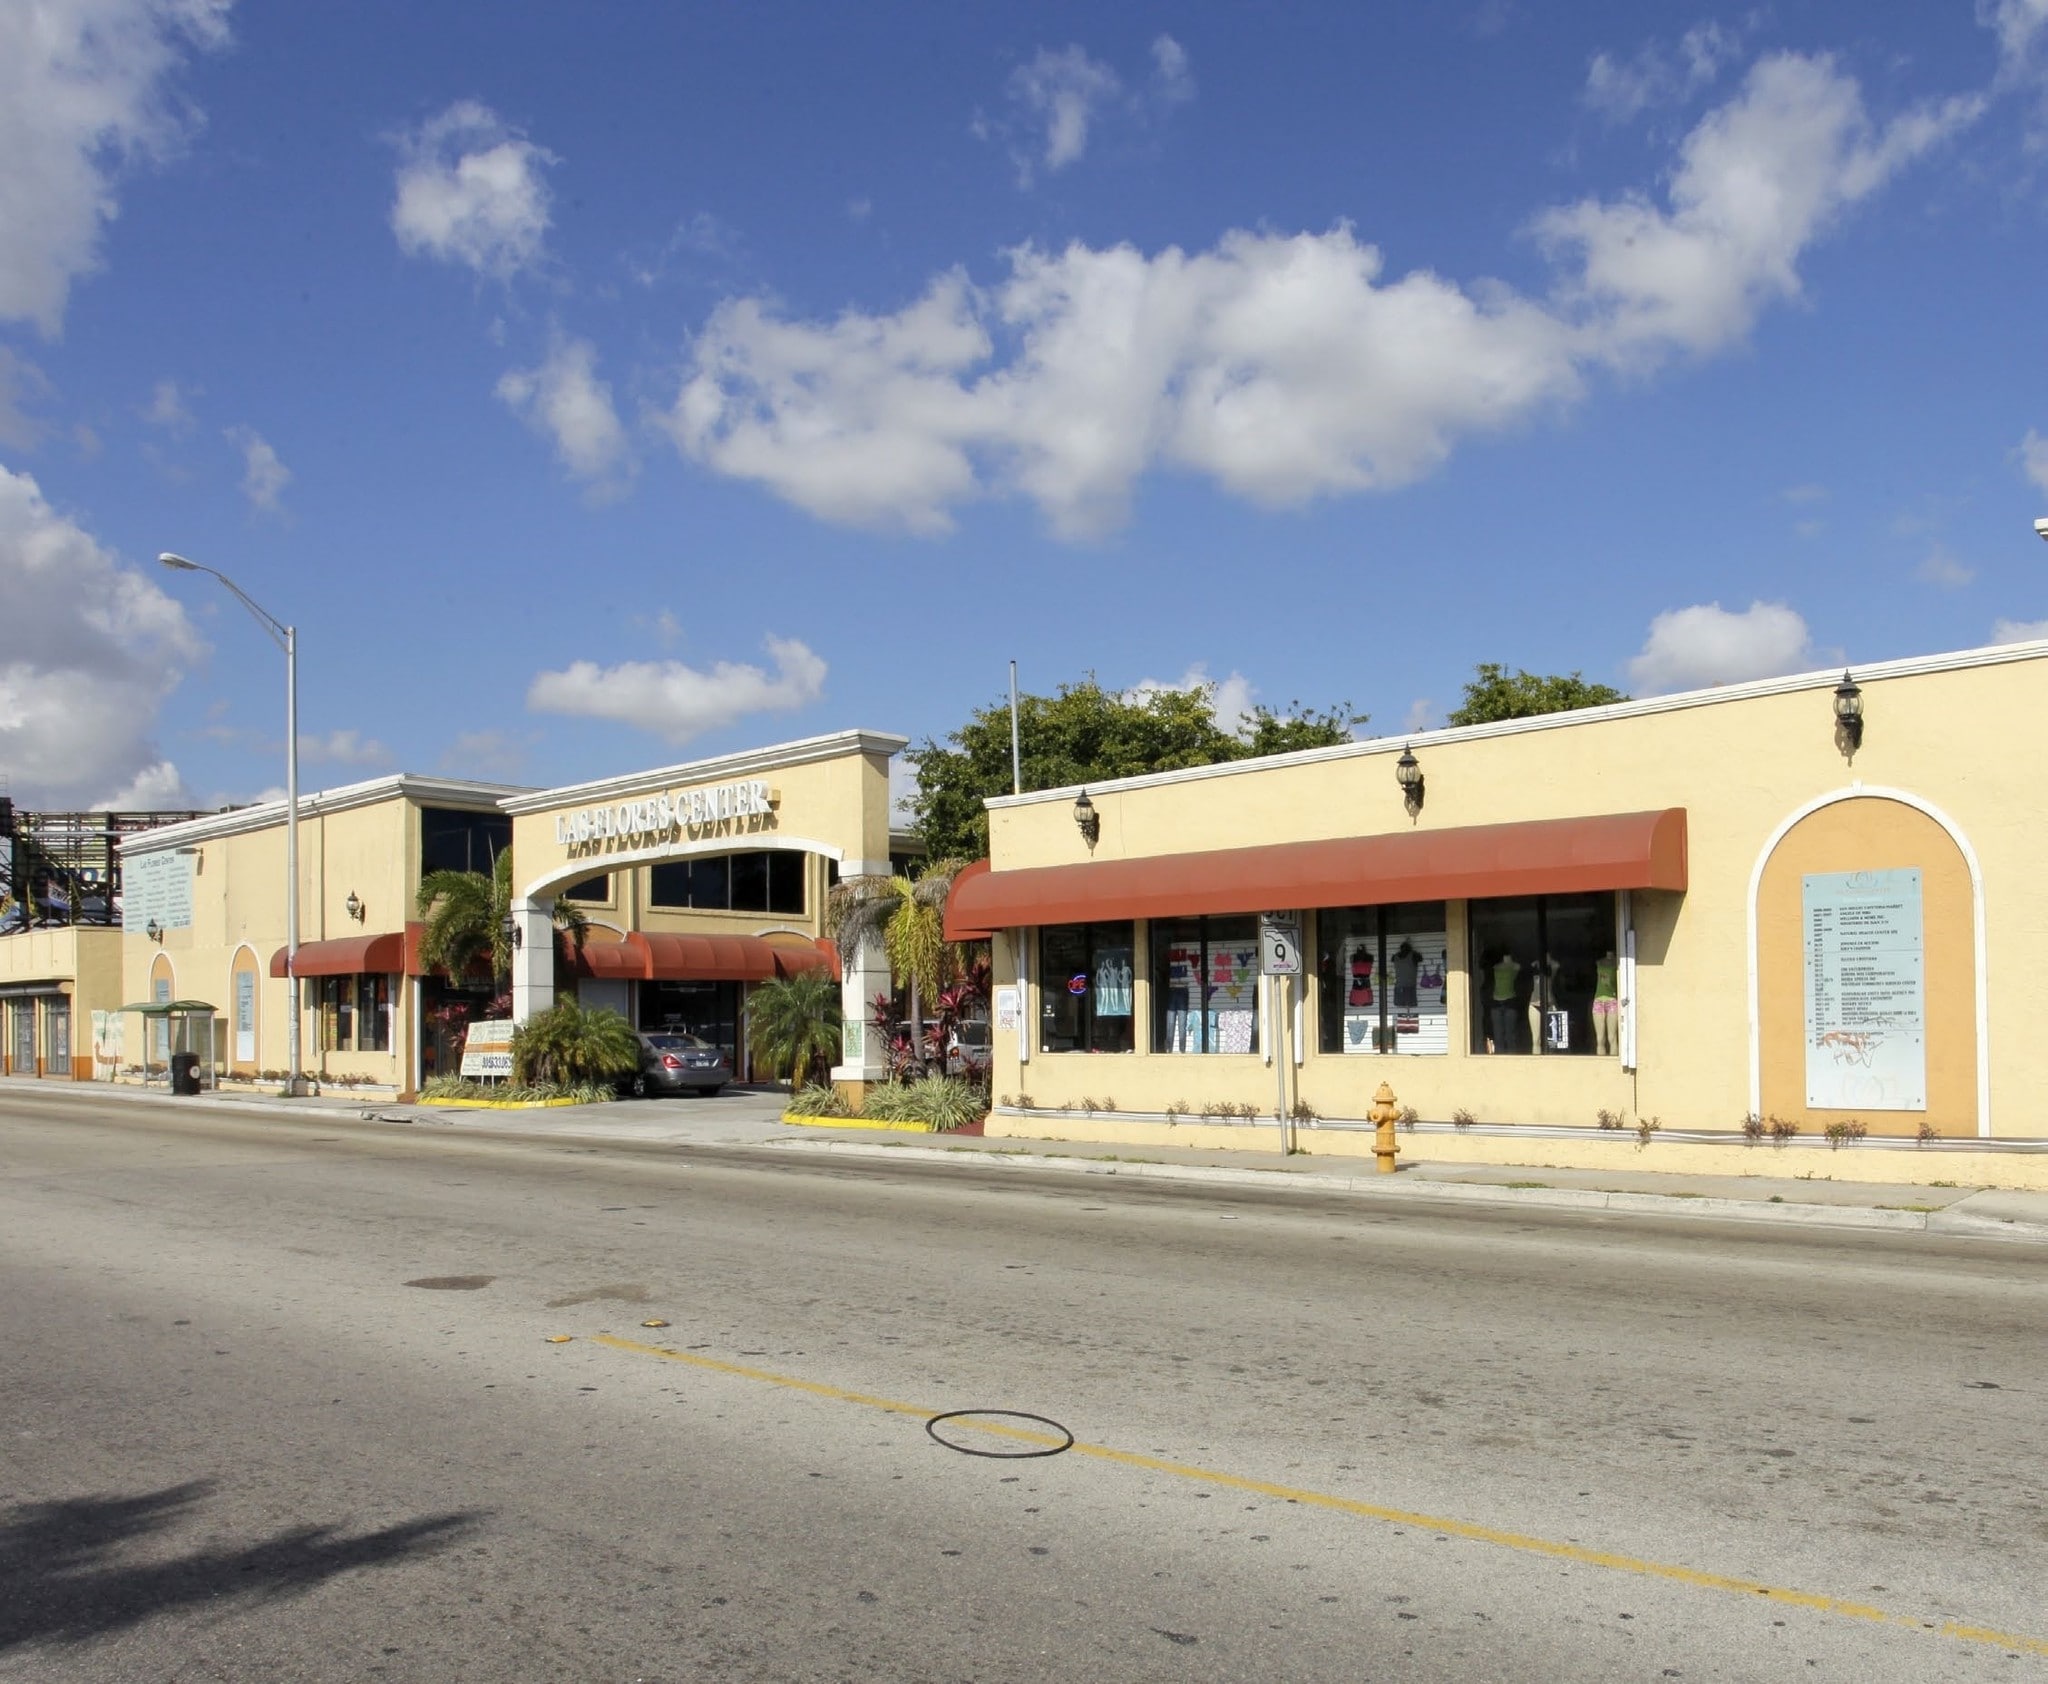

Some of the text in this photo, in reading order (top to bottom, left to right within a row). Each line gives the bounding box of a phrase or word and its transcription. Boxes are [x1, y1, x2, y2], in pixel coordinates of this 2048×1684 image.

[555, 780, 772, 844] LAS FLORES CENTER
[1275, 943, 1286, 962] 9
